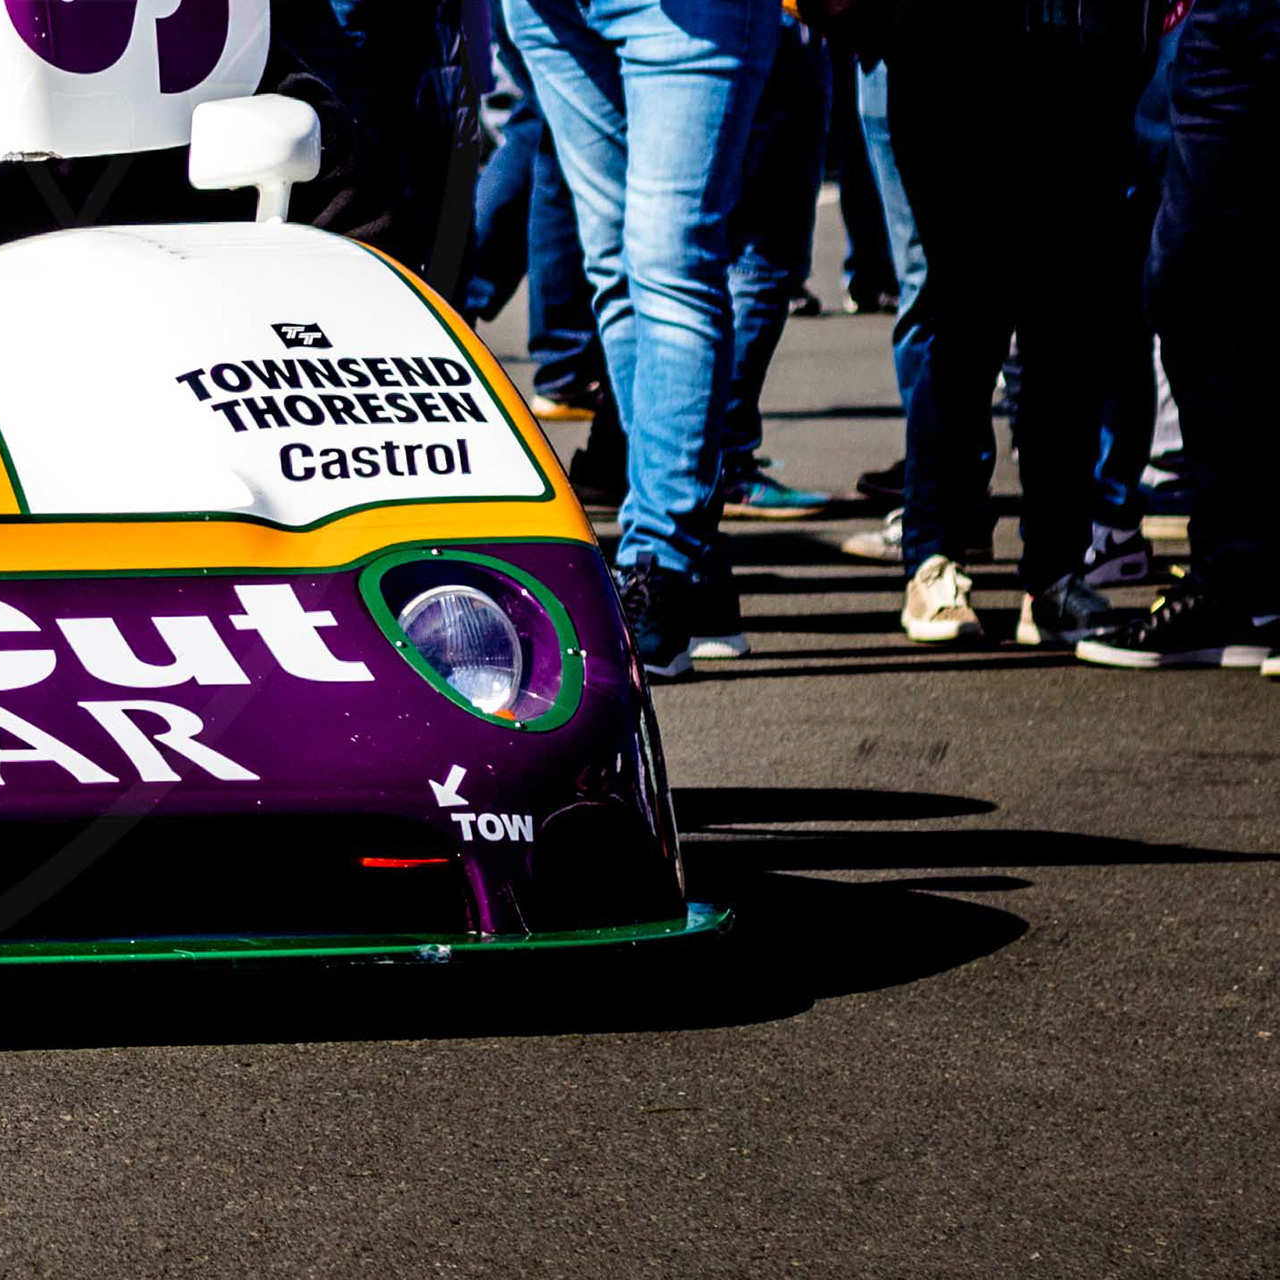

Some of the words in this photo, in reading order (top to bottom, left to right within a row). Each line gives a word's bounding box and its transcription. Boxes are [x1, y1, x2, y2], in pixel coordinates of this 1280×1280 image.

[175, 357, 474, 403] TOWNSEND
[211, 393, 489, 434] THORESEN
[279, 438, 472, 483] Castrol
[451, 811, 535, 843] TOW
